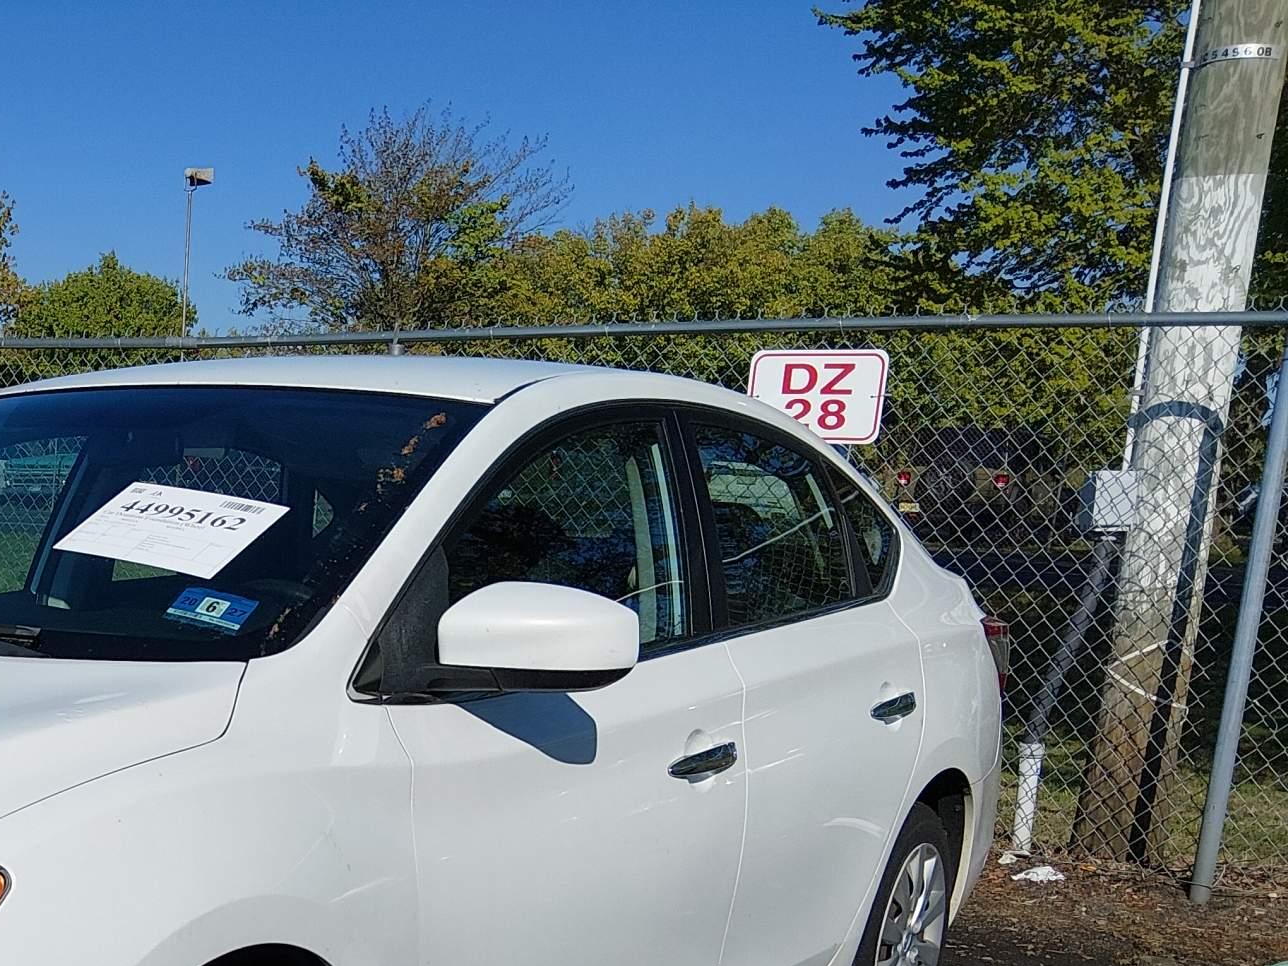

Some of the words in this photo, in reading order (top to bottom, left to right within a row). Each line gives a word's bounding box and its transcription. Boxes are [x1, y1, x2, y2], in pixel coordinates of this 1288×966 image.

[781, 363, 856, 395] DZ
[784, 398, 847, 431] 28
[120, 500, 247, 530] 44995162
[205, 600, 219, 613] 6
